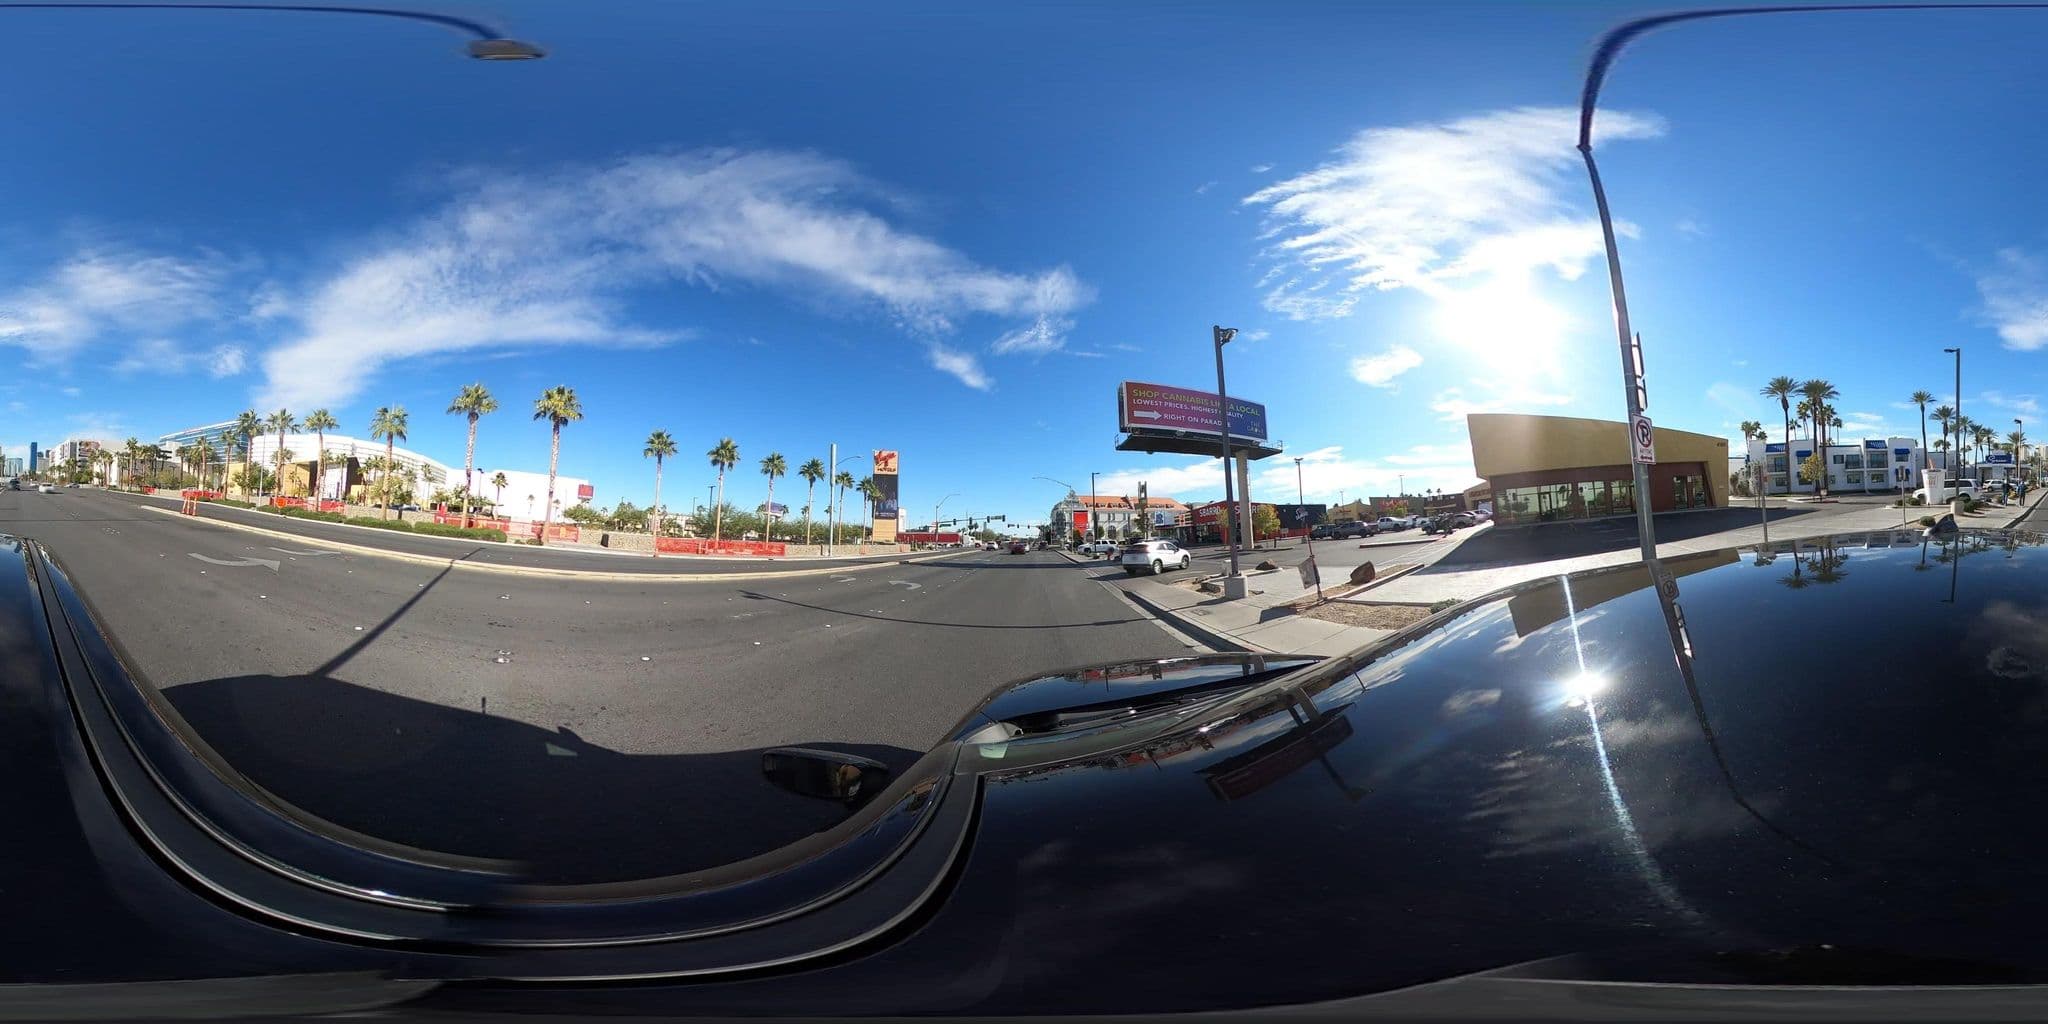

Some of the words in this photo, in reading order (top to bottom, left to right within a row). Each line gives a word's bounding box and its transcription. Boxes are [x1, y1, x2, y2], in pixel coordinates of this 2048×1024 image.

[1132, 389, 1160, 399] SHOP
[1161, 392, 1209, 406] CANNABIS
[1228, 403, 1236, 411] A
[1132, 398, 1163, 407] LOWEST
[1191, 405, 1218, 415] HIGHEST
[1163, 413, 1186, 421] RIGHT
[1187, 415, 1199, 423] ON
[1200, 417, 1231, 428] PARADE
